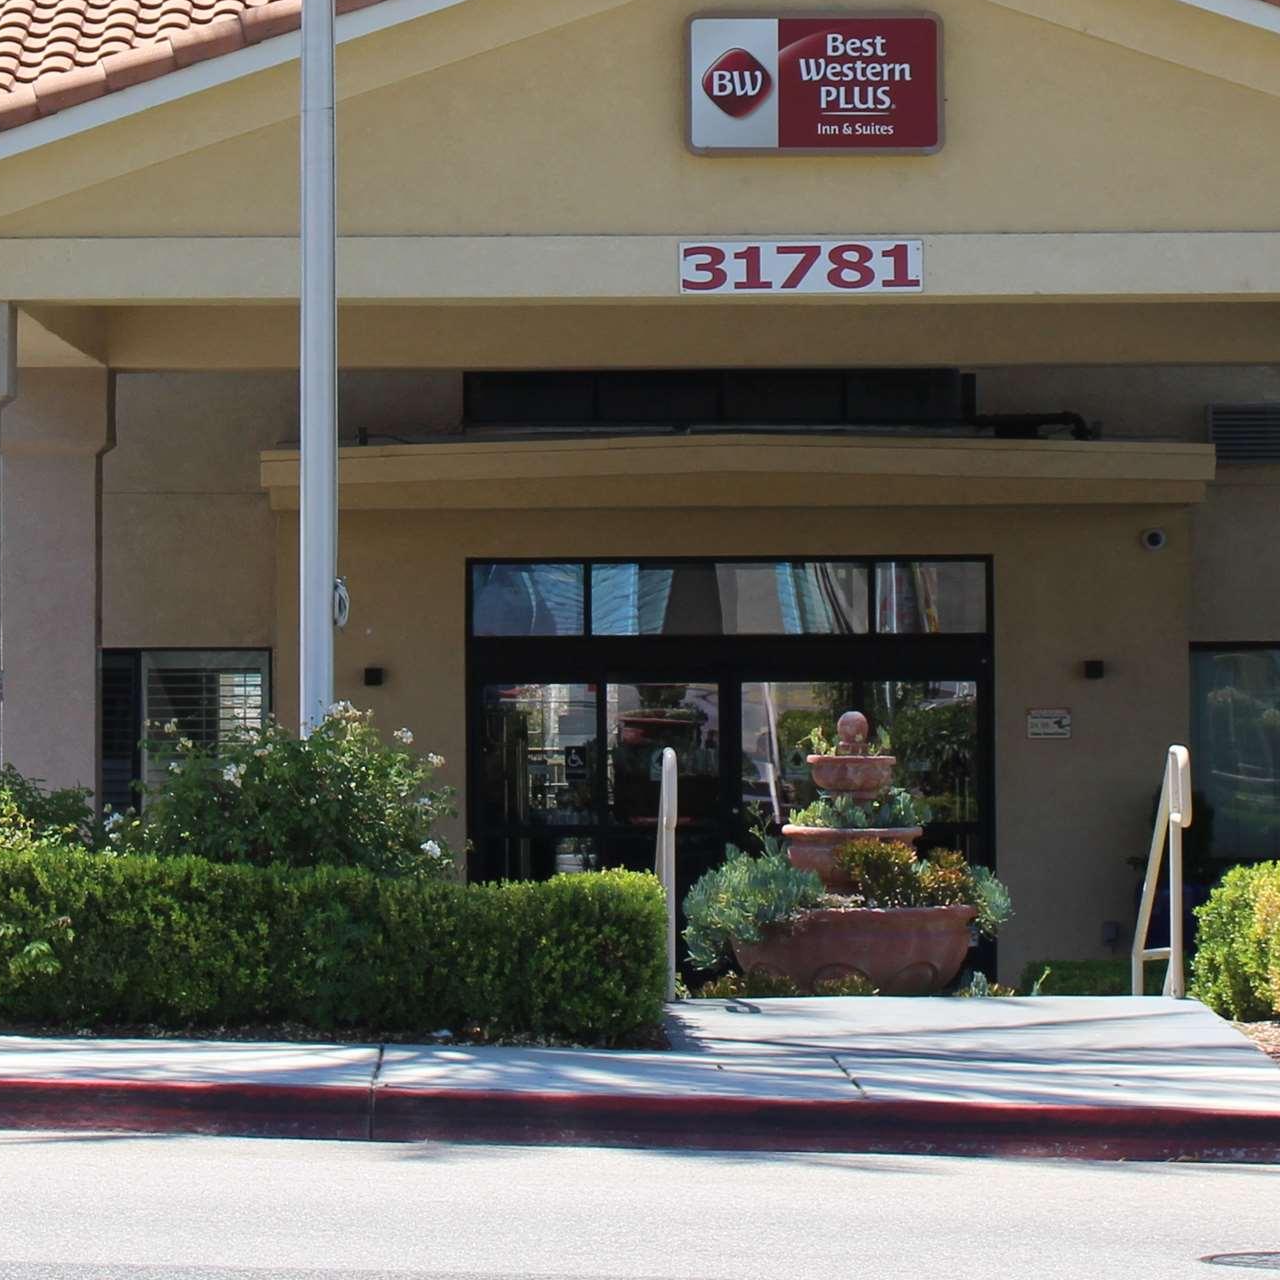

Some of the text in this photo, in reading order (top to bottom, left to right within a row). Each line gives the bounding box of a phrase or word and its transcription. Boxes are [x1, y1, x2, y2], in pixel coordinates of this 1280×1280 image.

[826, 33, 887, 57] Best
[798, 58, 912, 81] Western
[712, 70, 763, 97] BW
[820, 86, 892, 109] PLUS
[817, 123, 894, 135] Inn & Suites
[682, 243, 921, 291] 31781
